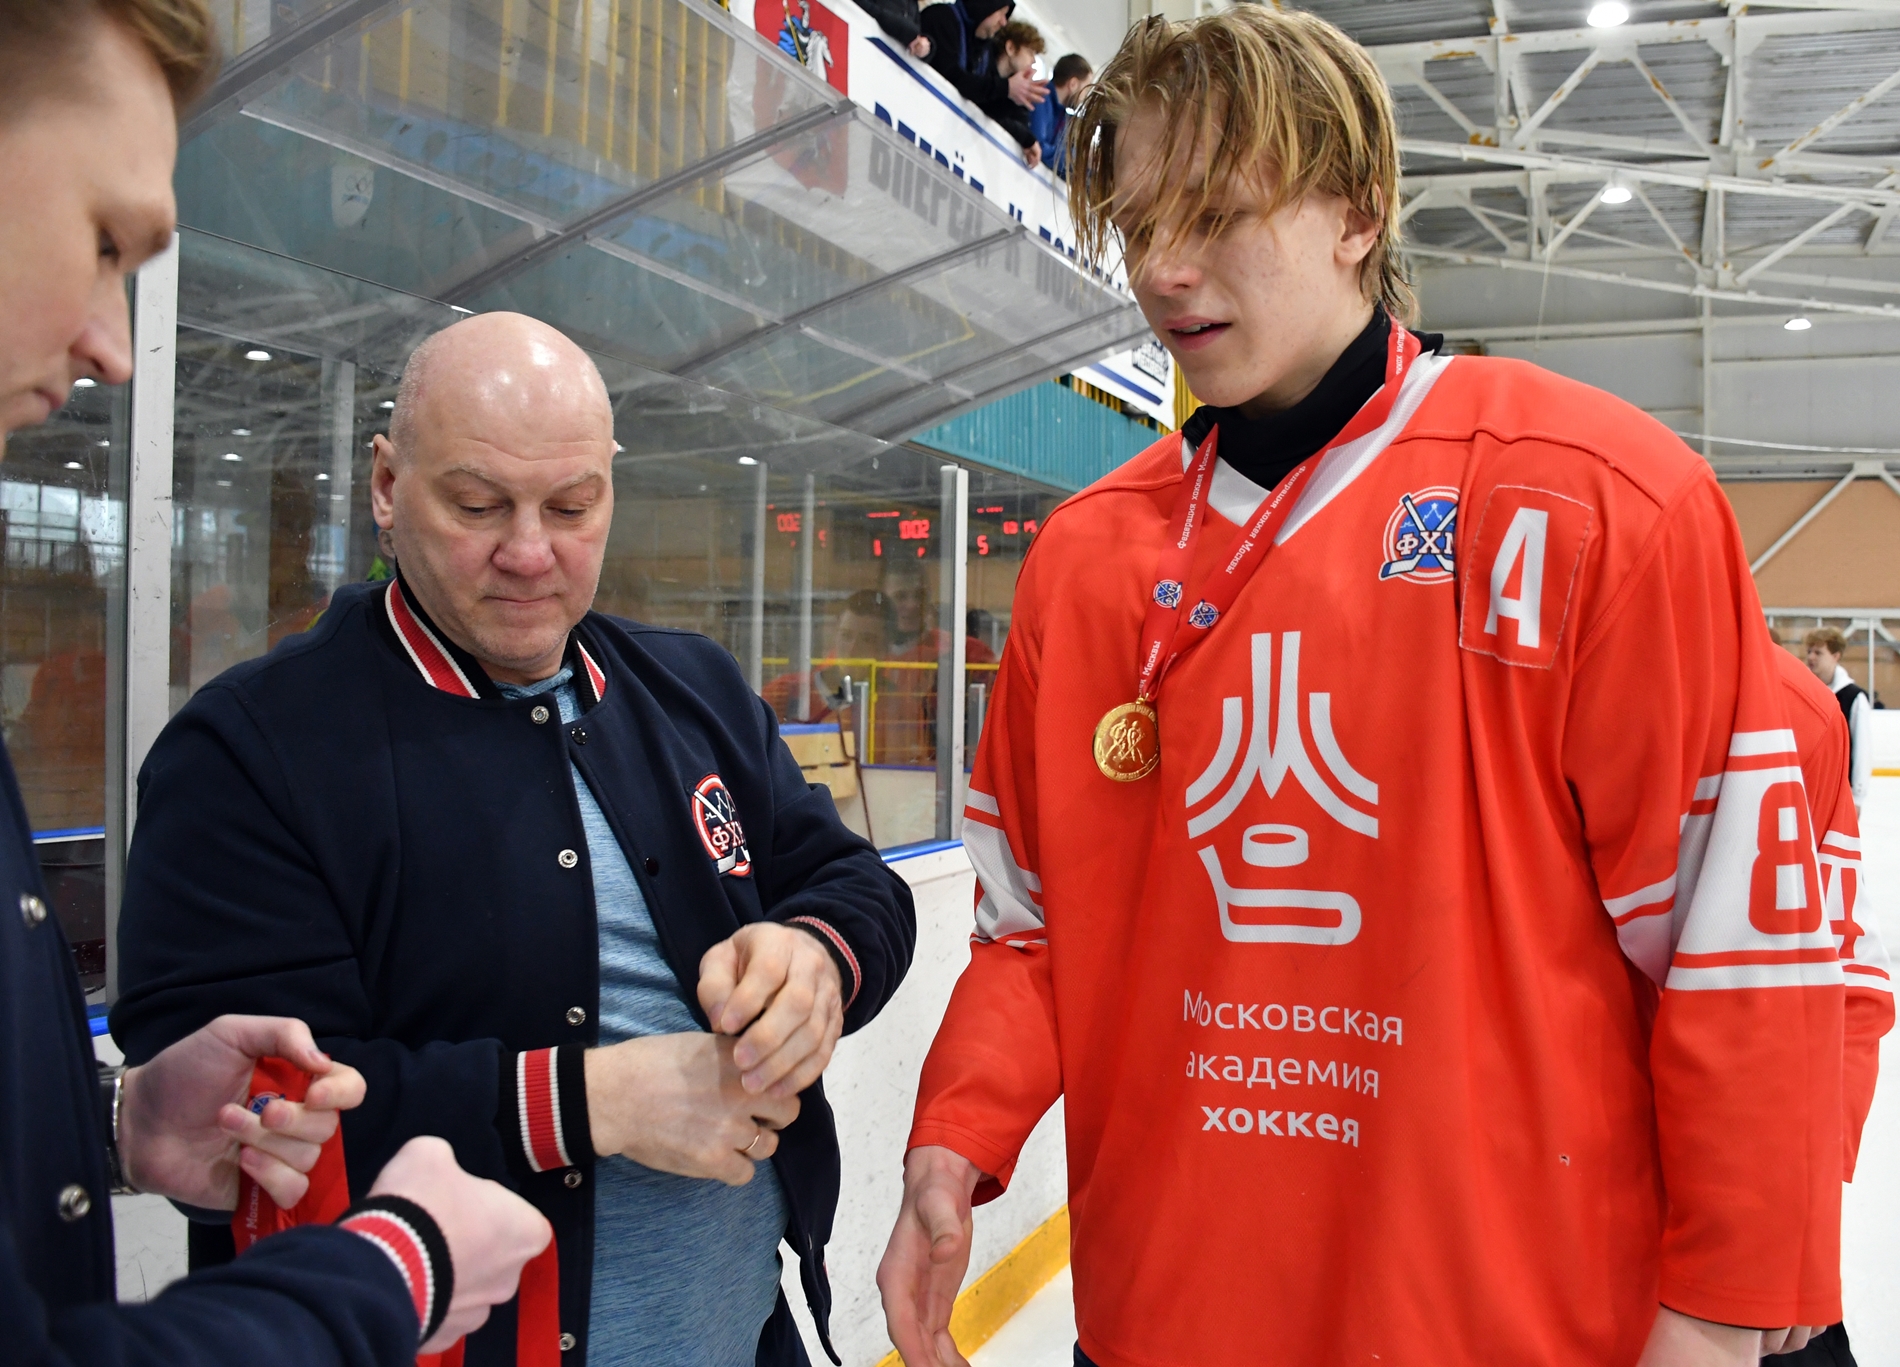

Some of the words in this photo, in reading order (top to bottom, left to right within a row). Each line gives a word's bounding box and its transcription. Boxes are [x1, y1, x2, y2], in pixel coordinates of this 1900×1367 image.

[1177, 503, 1196, 549] Федерация
[1192, 474, 1204, 500] хоккея
[1198, 442, 1212, 472] Москвы
[1249, 510, 1272, 539] хоккея
[1225, 539, 1254, 575] Москвы
[1484, 507, 1548, 648] A
[1142, 640, 1161, 676] Москвы
[1748, 781, 1823, 935] 8
[1183, 989, 1403, 1046] Московская
[1185, 1051, 1379, 1098] академия
[1201, 1105, 1359, 1148] хоккея
